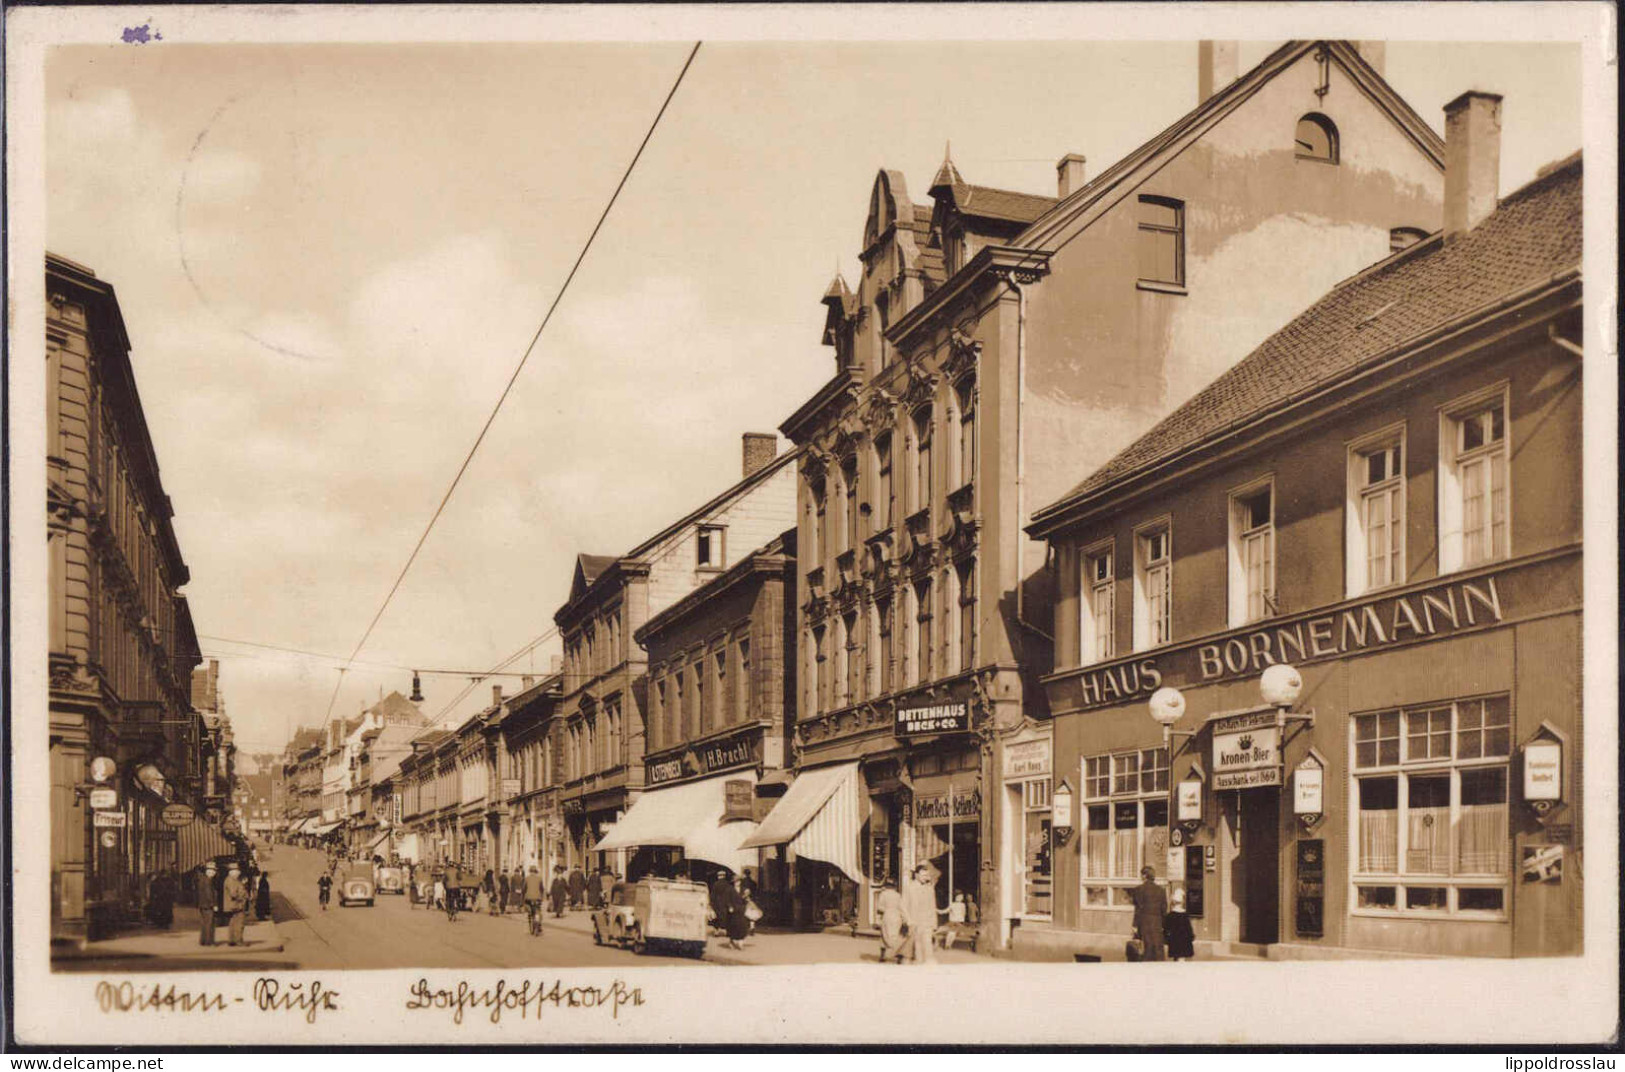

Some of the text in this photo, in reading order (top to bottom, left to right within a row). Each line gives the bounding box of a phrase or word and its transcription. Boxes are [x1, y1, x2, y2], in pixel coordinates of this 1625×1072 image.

[1080, 576, 1502, 704] HAUS BORNEMANN
[898, 704, 965, 722] BETTENHAUS
